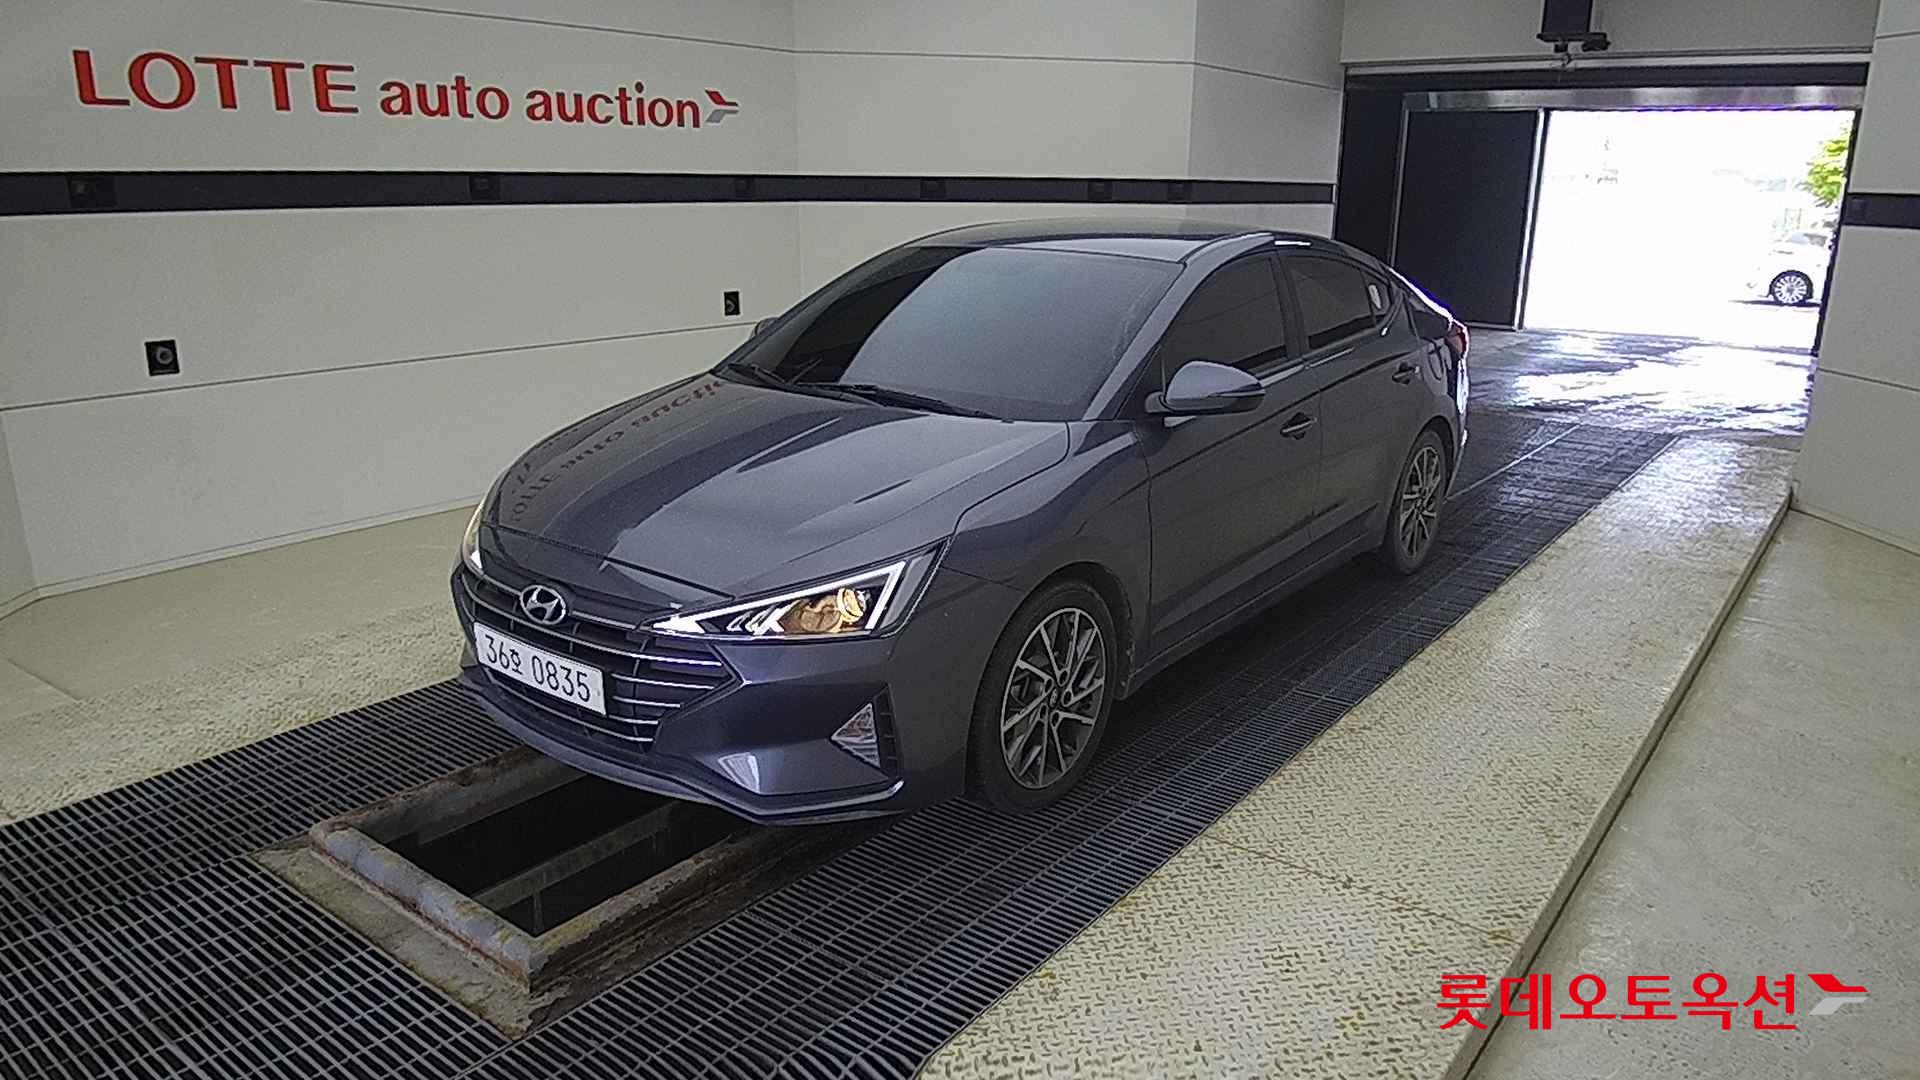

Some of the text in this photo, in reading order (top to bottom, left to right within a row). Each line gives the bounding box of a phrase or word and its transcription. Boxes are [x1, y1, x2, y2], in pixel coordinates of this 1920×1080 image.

[73, 49, 701, 129] LOTTE auto auction
[485, 634, 590, 702] 36호 0835
